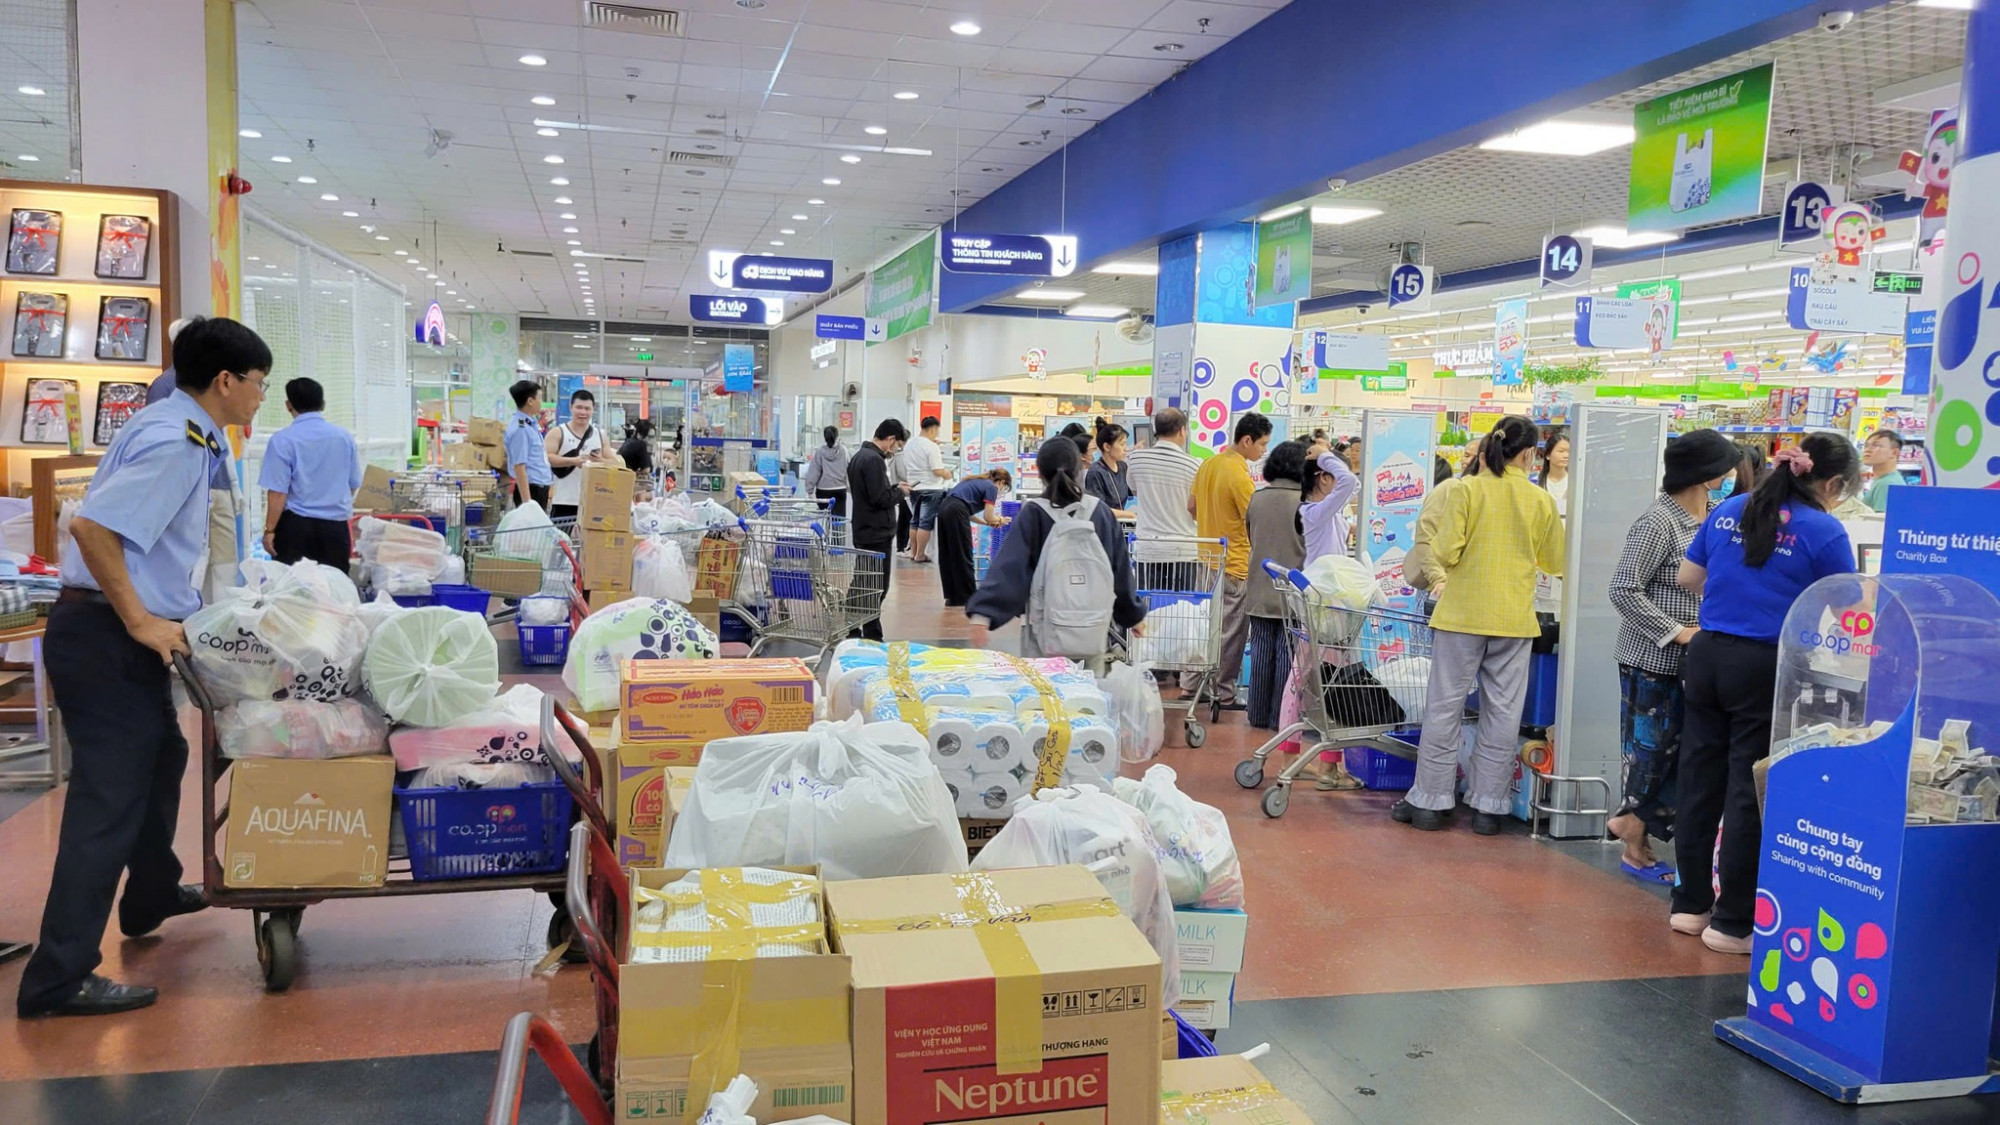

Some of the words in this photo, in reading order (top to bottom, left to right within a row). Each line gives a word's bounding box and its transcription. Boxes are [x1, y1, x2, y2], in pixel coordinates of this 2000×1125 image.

[1791, 196, 1826, 231] 13
[952, 238, 974, 248] TRUY
[1548, 245, 1578, 272] 14
[1394, 273, 1420, 296] 15
[1793, 274, 1808, 288] 10
[1906, 280, 1921, 288] EXIT
[1577, 301, 1590, 314] 11
[1316, 335, 1326, 344] 12
[1897, 529, 1948, 551] Thùng
[1951, 533, 1971, 549] từ
[1896, 550, 1928, 564] Charity
[1929, 552, 1948, 563] Box
[1800, 630, 1850, 655] co.op
[1796, 818, 1839, 845] Chung
[1842, 833, 1864, 853] tay
[1094, 840, 1126, 862] art
[1776, 833, 1809, 855] cùng
[1810, 845, 1844, 867] cộng
[1846, 855, 1882, 880] đồng
[1771, 850, 1806, 873] Sharing
[1807, 863, 1827, 879] with
[1828, 872, 1885, 901] community
[1177, 924, 1217, 941] MILK
[1181, 978, 1206, 995] ILK
[894, 1028, 915, 1039] VIỆN
[915, 1028, 922, 1037] Y
[922, 1026, 941, 1038] HỌC
[963, 1022, 988, 1034] DỤNG
[921, 1037, 940, 1048] VIỆT
[940, 1036, 962, 1046] NAM
[1041, 1040, 1080, 1053] THƯỢNG
[1081, 1037, 1109, 1050] HẠNG
[935, 1070, 1099, 1114] Neptune
